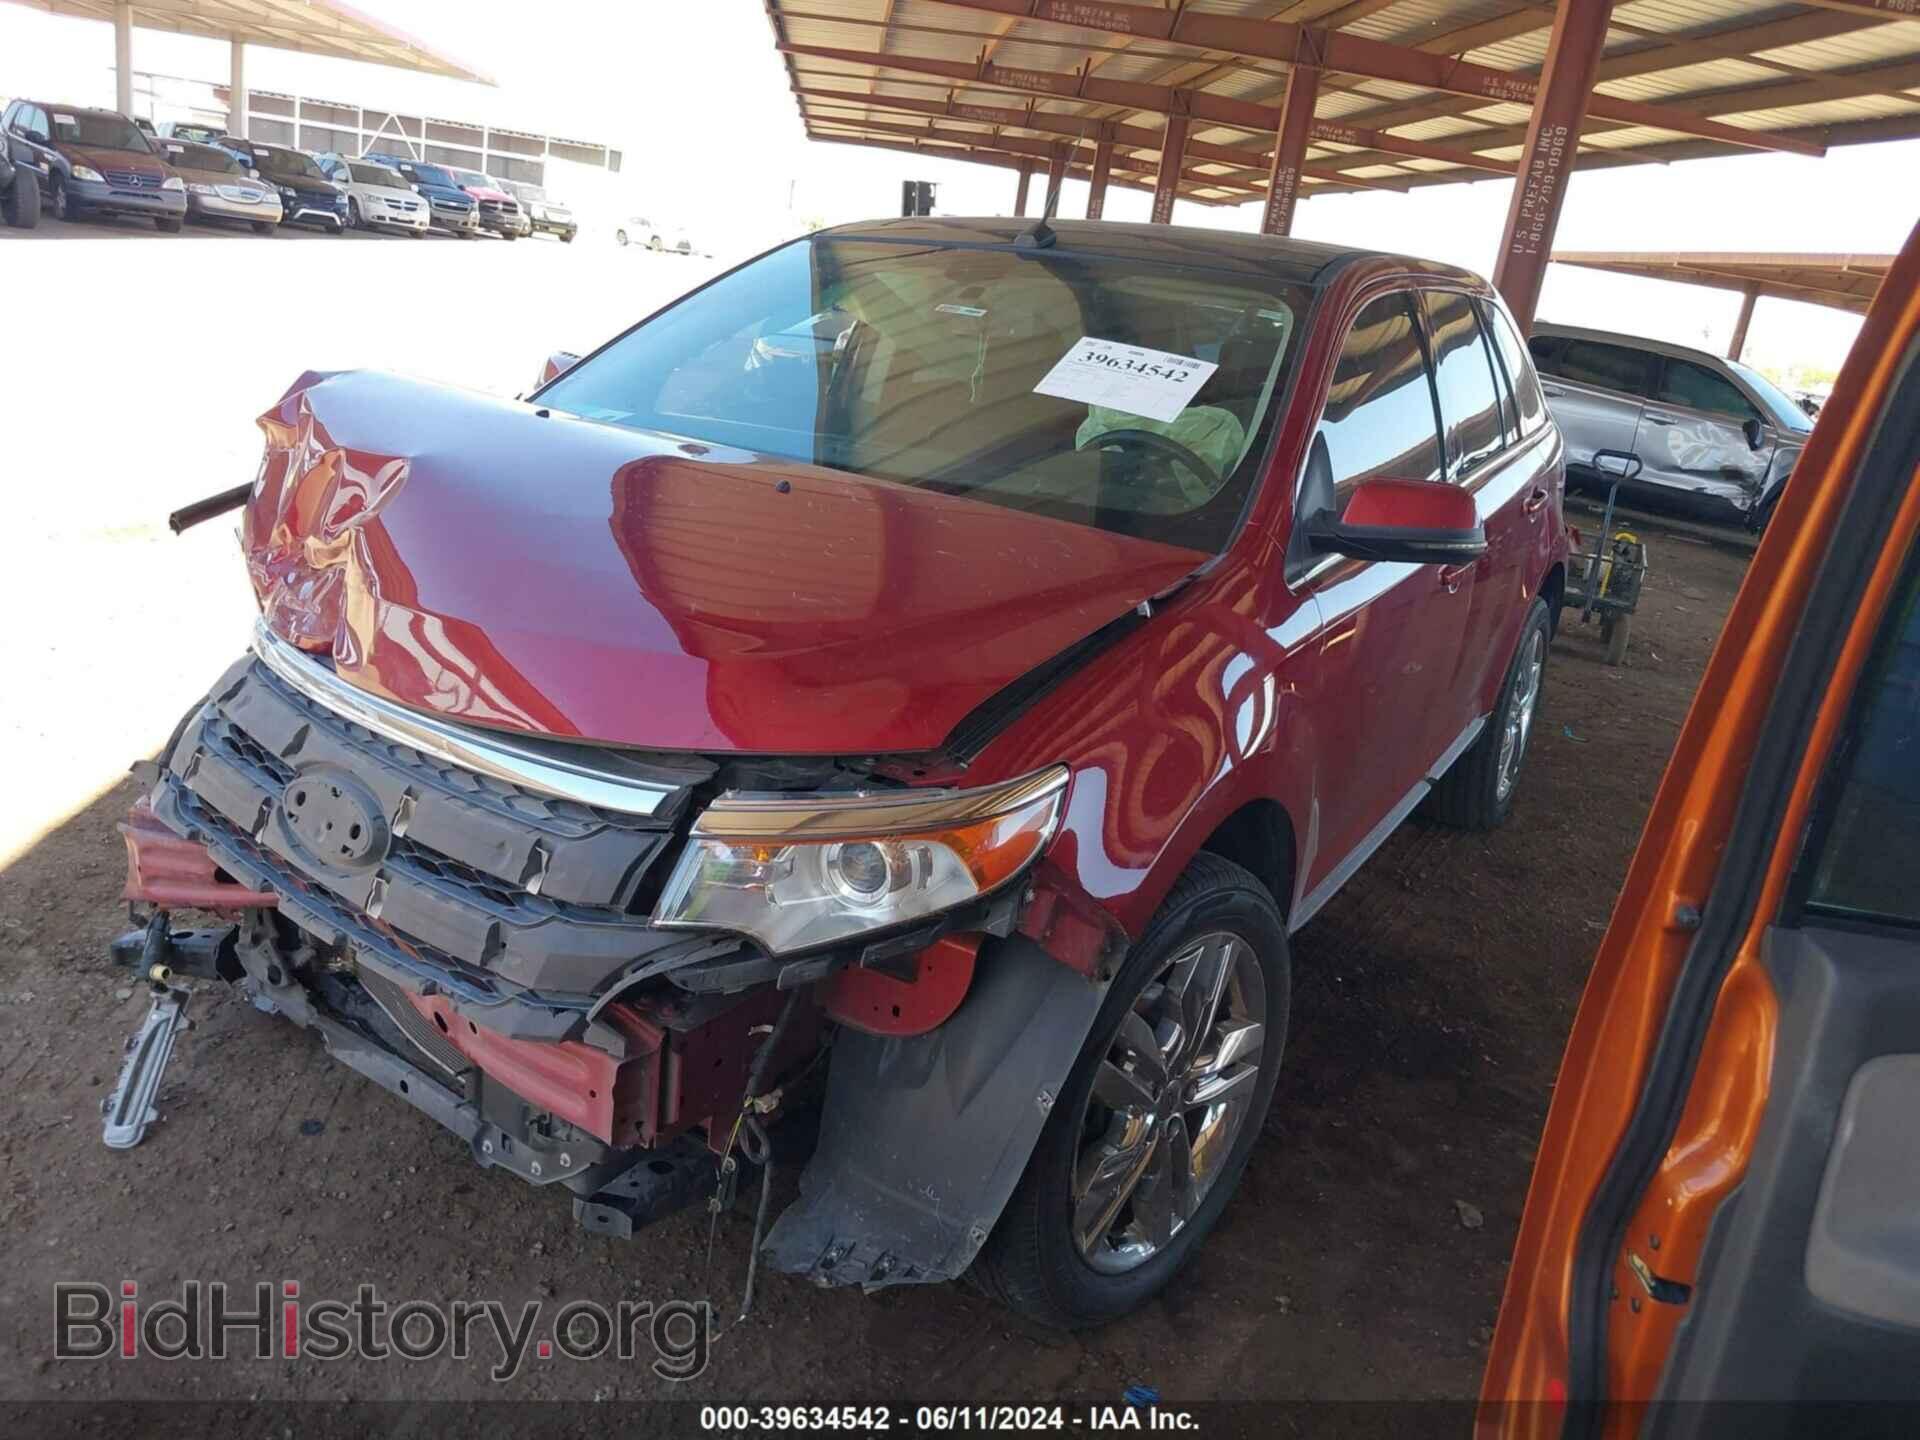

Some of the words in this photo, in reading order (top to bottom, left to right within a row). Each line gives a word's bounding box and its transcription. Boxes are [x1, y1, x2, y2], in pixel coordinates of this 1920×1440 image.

[1522, 160, 1545, 217] PREFAB
[1525, 126, 1568, 254] 1-866-799-0969
[1078, 351, 1189, 382] 39634542
